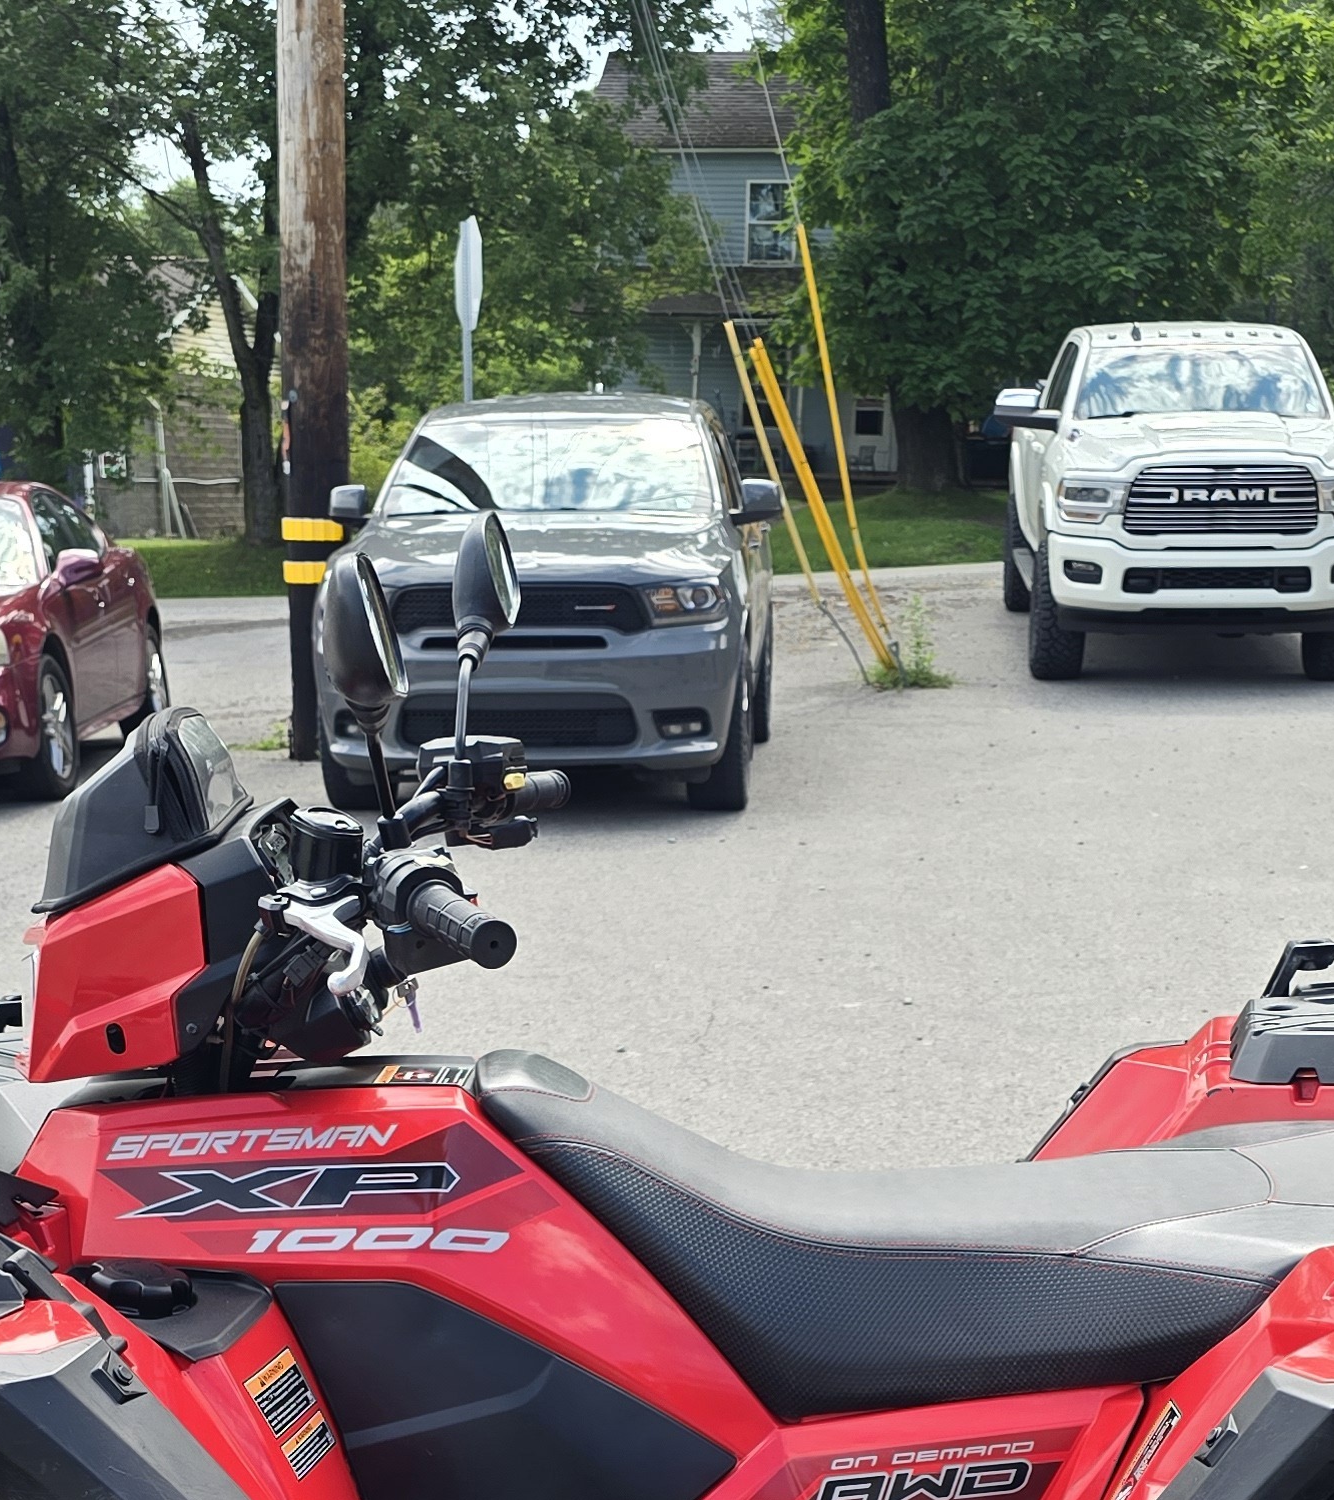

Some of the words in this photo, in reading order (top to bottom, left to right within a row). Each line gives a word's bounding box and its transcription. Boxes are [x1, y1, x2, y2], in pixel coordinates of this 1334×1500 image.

[1182, 487, 1266, 502] RAM
[105, 1123, 399, 1162] SPORTSMAN
[114, 1161, 462, 1221] XP
[245, 1226, 511, 1255] 1000
[261, 1361, 285, 1383] WARNING
[830, 1454, 879, 1471] ON
[890, 1440, 1035, 1466] DEMAND
